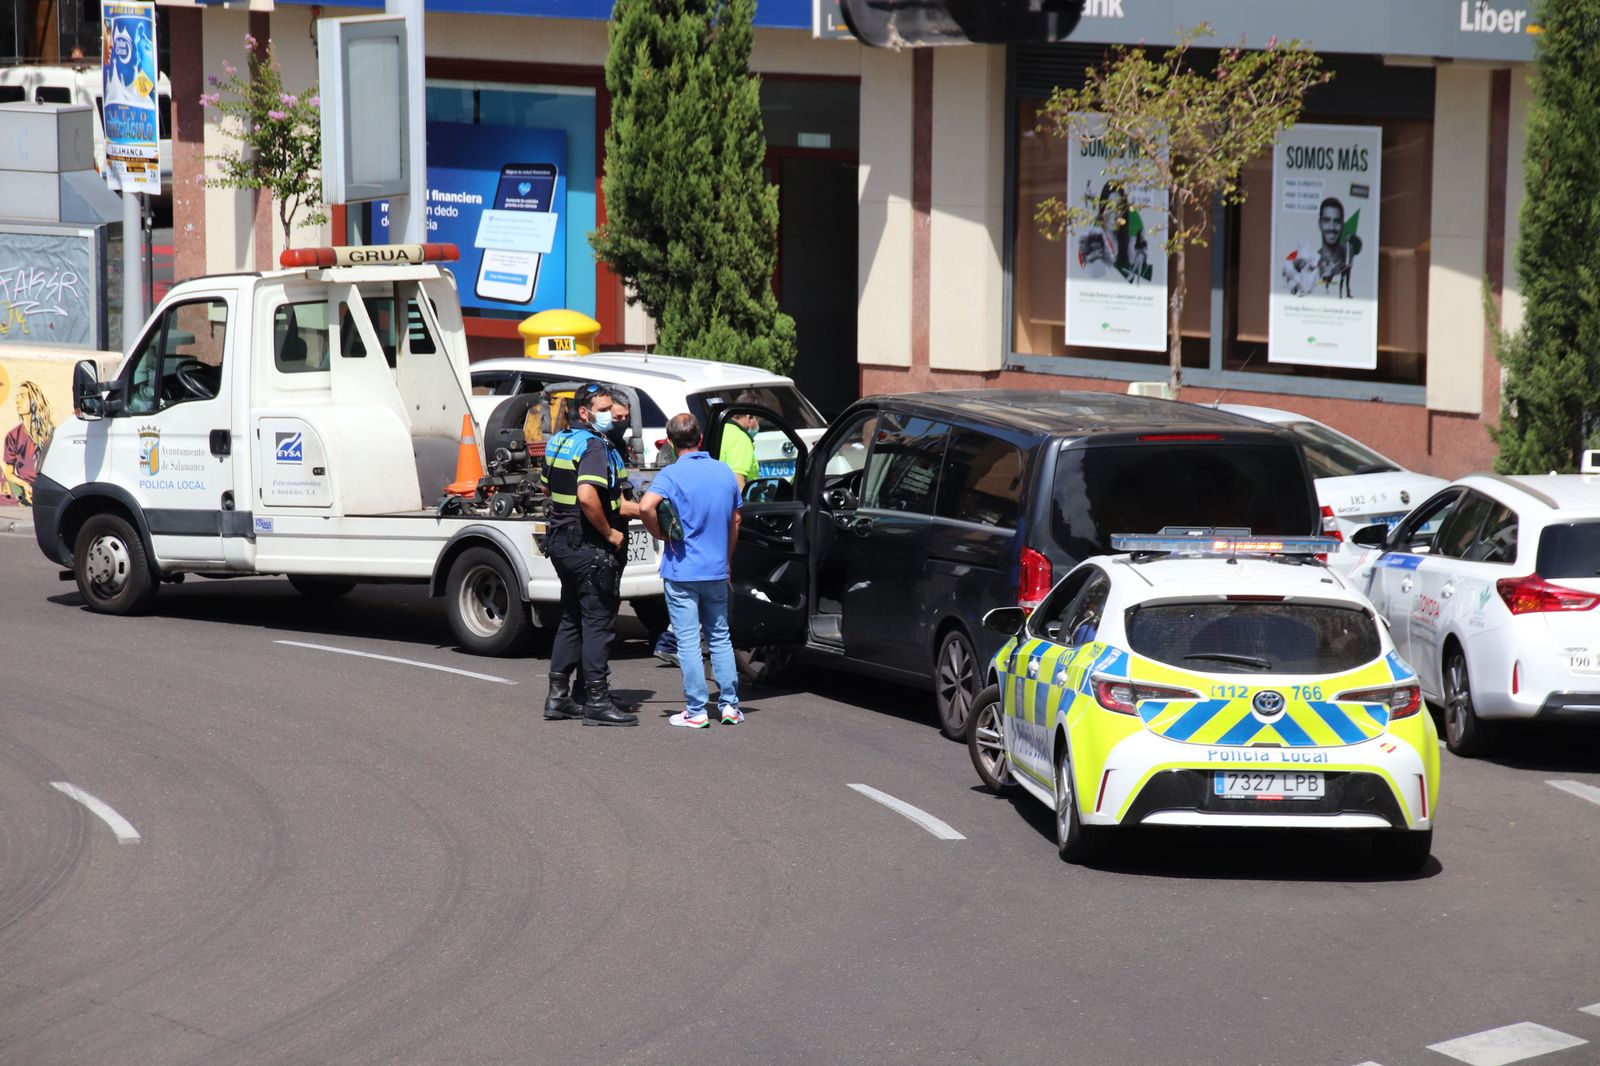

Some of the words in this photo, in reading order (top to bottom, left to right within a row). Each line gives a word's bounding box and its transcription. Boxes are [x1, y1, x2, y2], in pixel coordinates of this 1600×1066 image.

[111, 146, 144, 157] SALAMANCA
[1286, 145, 1334, 170] SOMOS
[1338, 143, 1369, 172] MÁS
[431, 189, 483, 205] financiera
[434, 204, 459, 217] dedo
[349, 249, 410, 262] GRUA
[554, 338, 571, 351] TAXI
[139, 480, 175, 489] POLICIA
[177, 481, 206, 490] LOCAL
[1570, 657, 1590, 667] 190
[1217, 685, 1249, 699] 112
[1291, 685, 1323, 701] 766
[1280, 751, 1329, 763] Local
[1228, 773, 1276, 791] 7327
[1283, 774, 1319, 792] LPB
